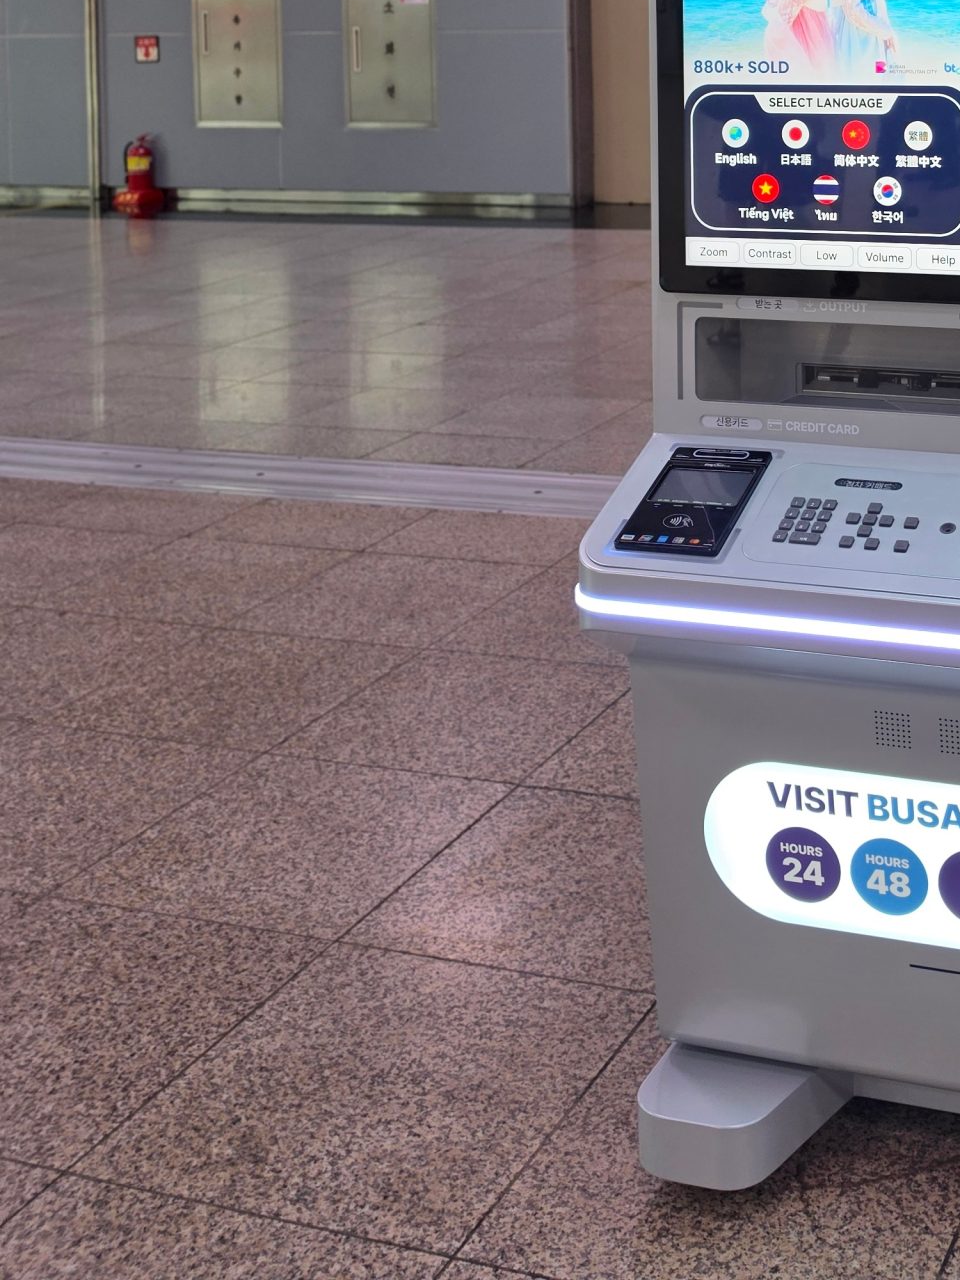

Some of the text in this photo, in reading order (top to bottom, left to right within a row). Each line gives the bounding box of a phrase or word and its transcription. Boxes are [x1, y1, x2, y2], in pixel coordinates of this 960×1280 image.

[693, 60, 790, 75] 880k+ SOLD
[769, 97, 883, 108] SELECT LANGUAGE
[908, 130, 929, 142] 繁體
[715, 152, 757, 167] English
[780, 154, 812, 166] 日本語
[834, 154, 880, 167] 简体中文
[895, 155, 942, 168] 繁體中文
[738, 207, 795, 222] Tiếng Việt
[814, 208, 838, 222] ไทย
[871, 210, 904, 224] 한국어
[700, 247, 728, 257] Zoom
[748, 248, 792, 259] Contrast
[816, 251, 837, 261] Low
[865, 252, 904, 263] Volume
[932, 255, 956, 267] Help
[755, 298, 782, 309] 받는 곳
[820, 301, 868, 313] OUTPUT
[785, 420, 860, 435] CREDIT CARD
[766, 780, 859, 818] VISIT
[780, 841, 823, 858] HOURS
[865, 853, 910, 870] HOURS
[782, 858, 825, 887] 24
[866, 869, 911, 899] 48
